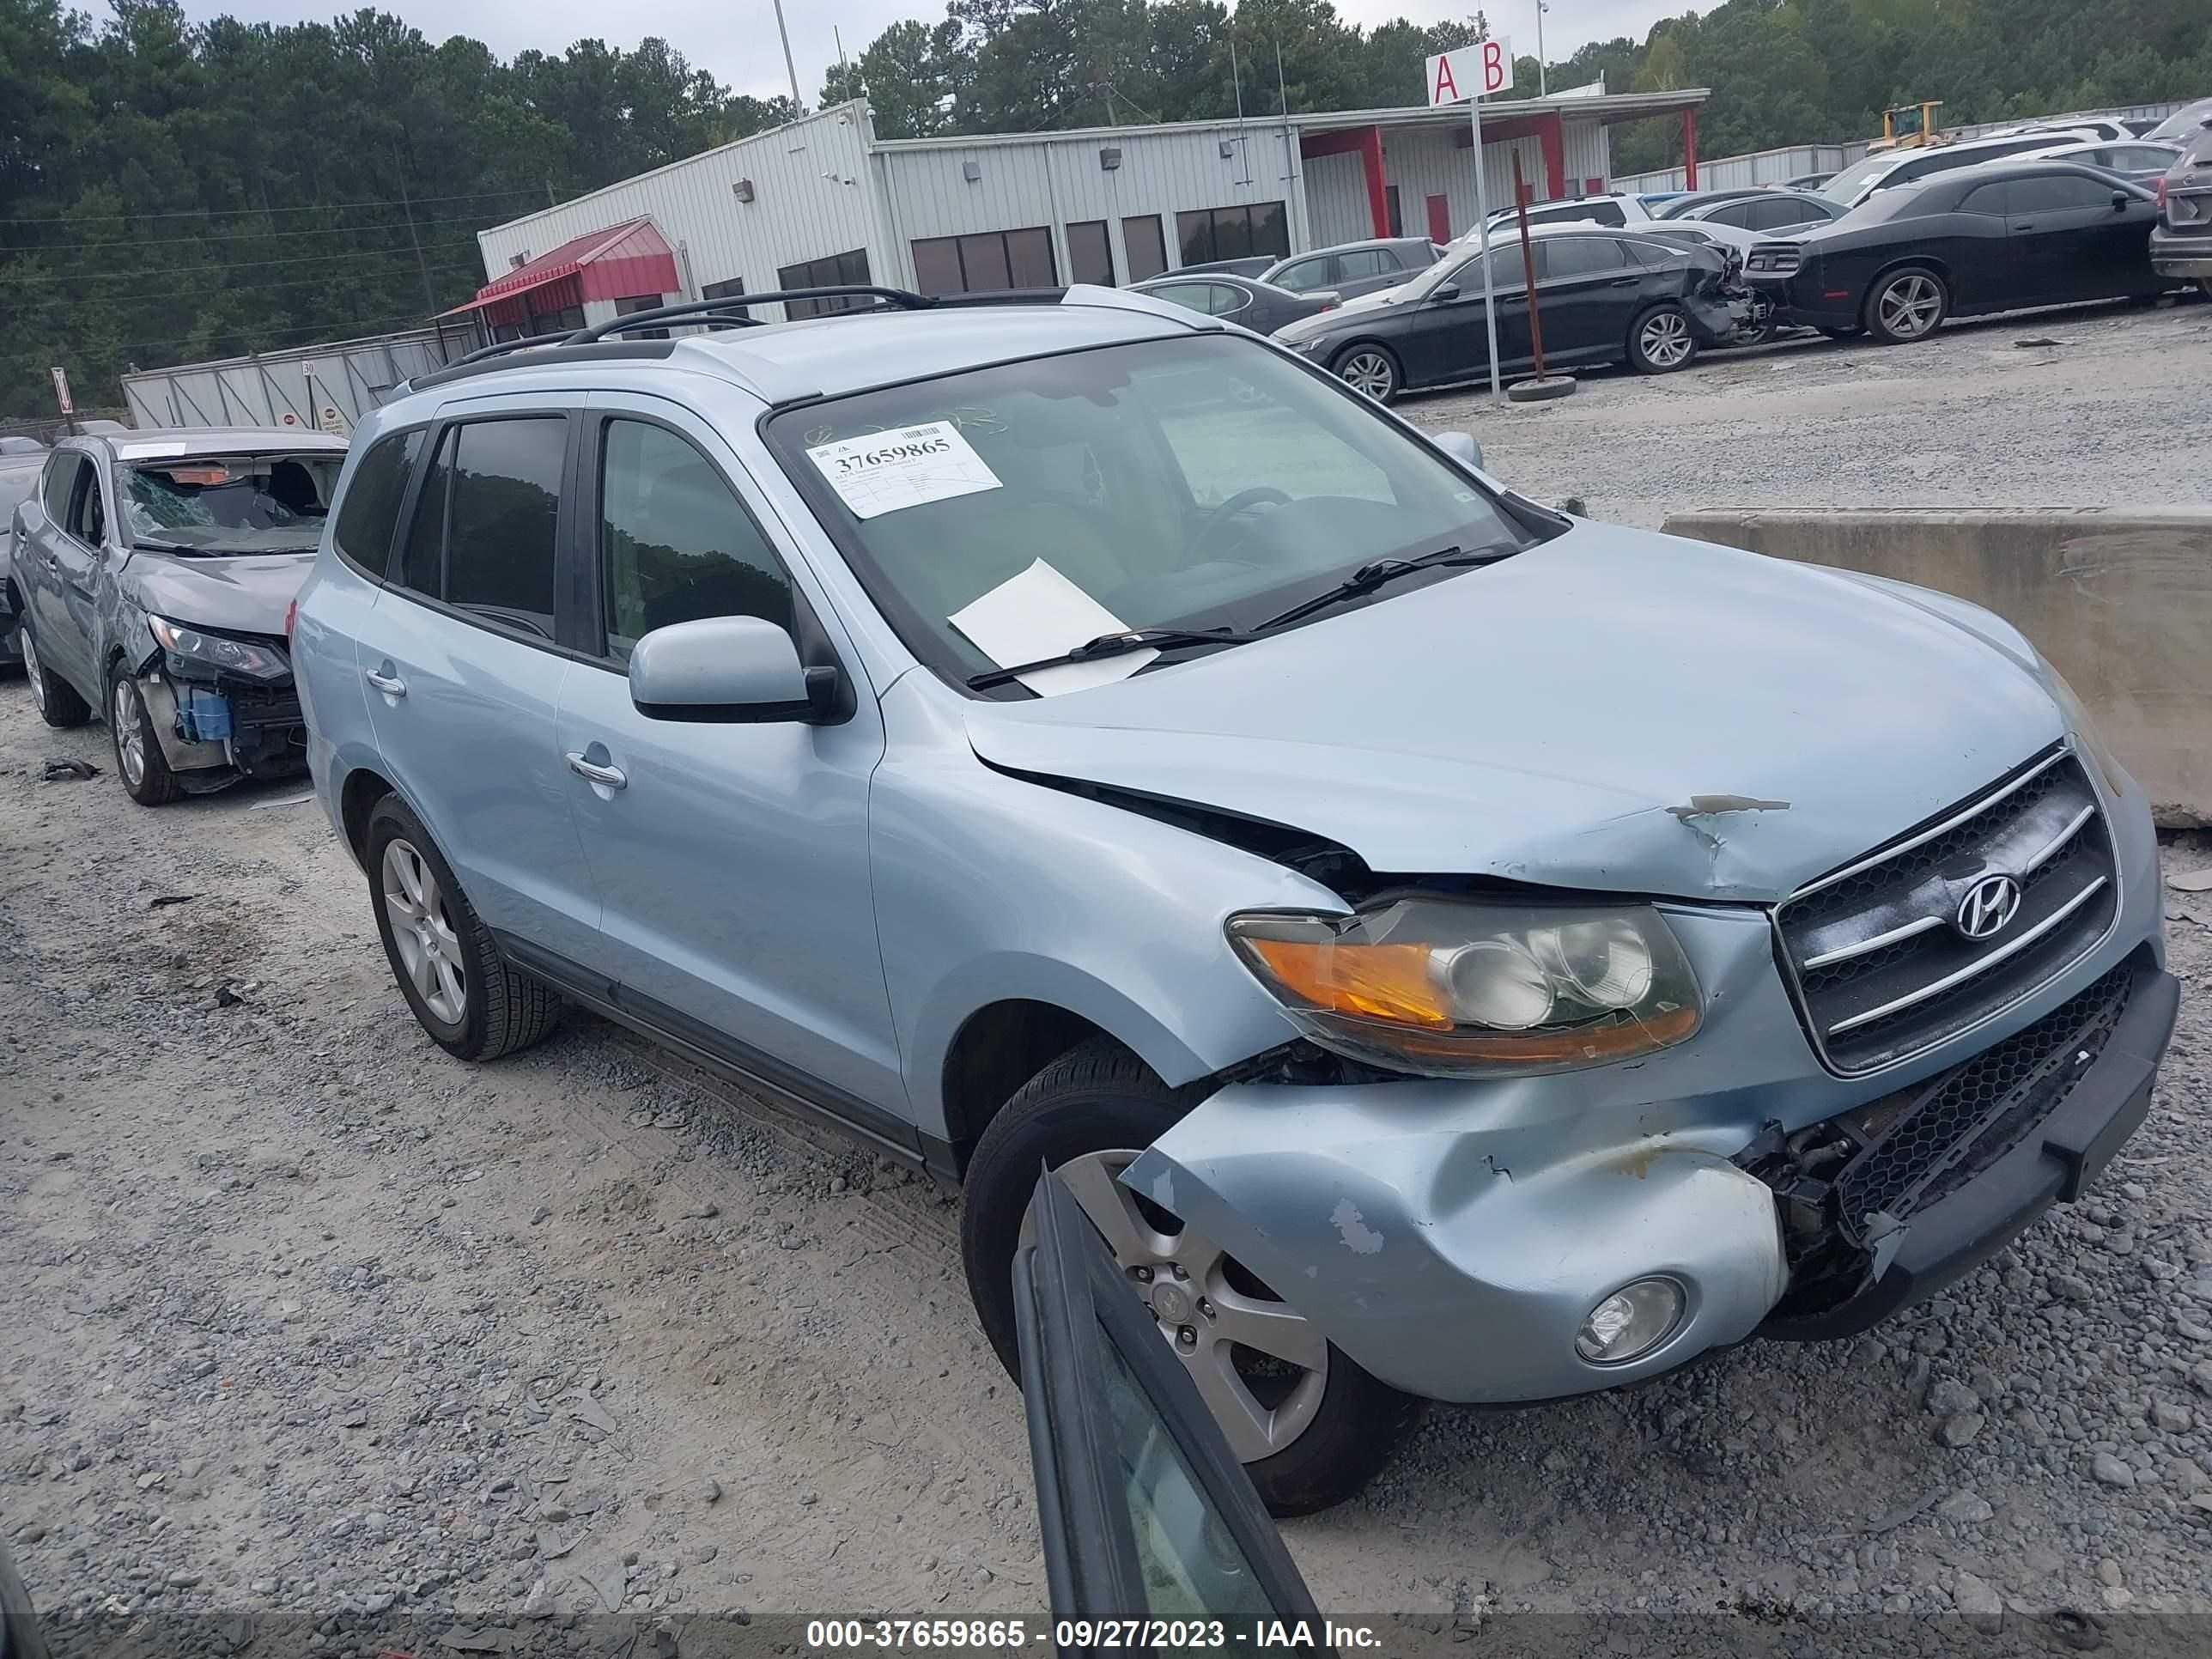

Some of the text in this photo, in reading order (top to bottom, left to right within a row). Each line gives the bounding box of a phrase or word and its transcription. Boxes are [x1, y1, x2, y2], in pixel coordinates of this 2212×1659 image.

[1435, 42, 1503, 103] A B
[835, 439, 951, 473] 37659865
